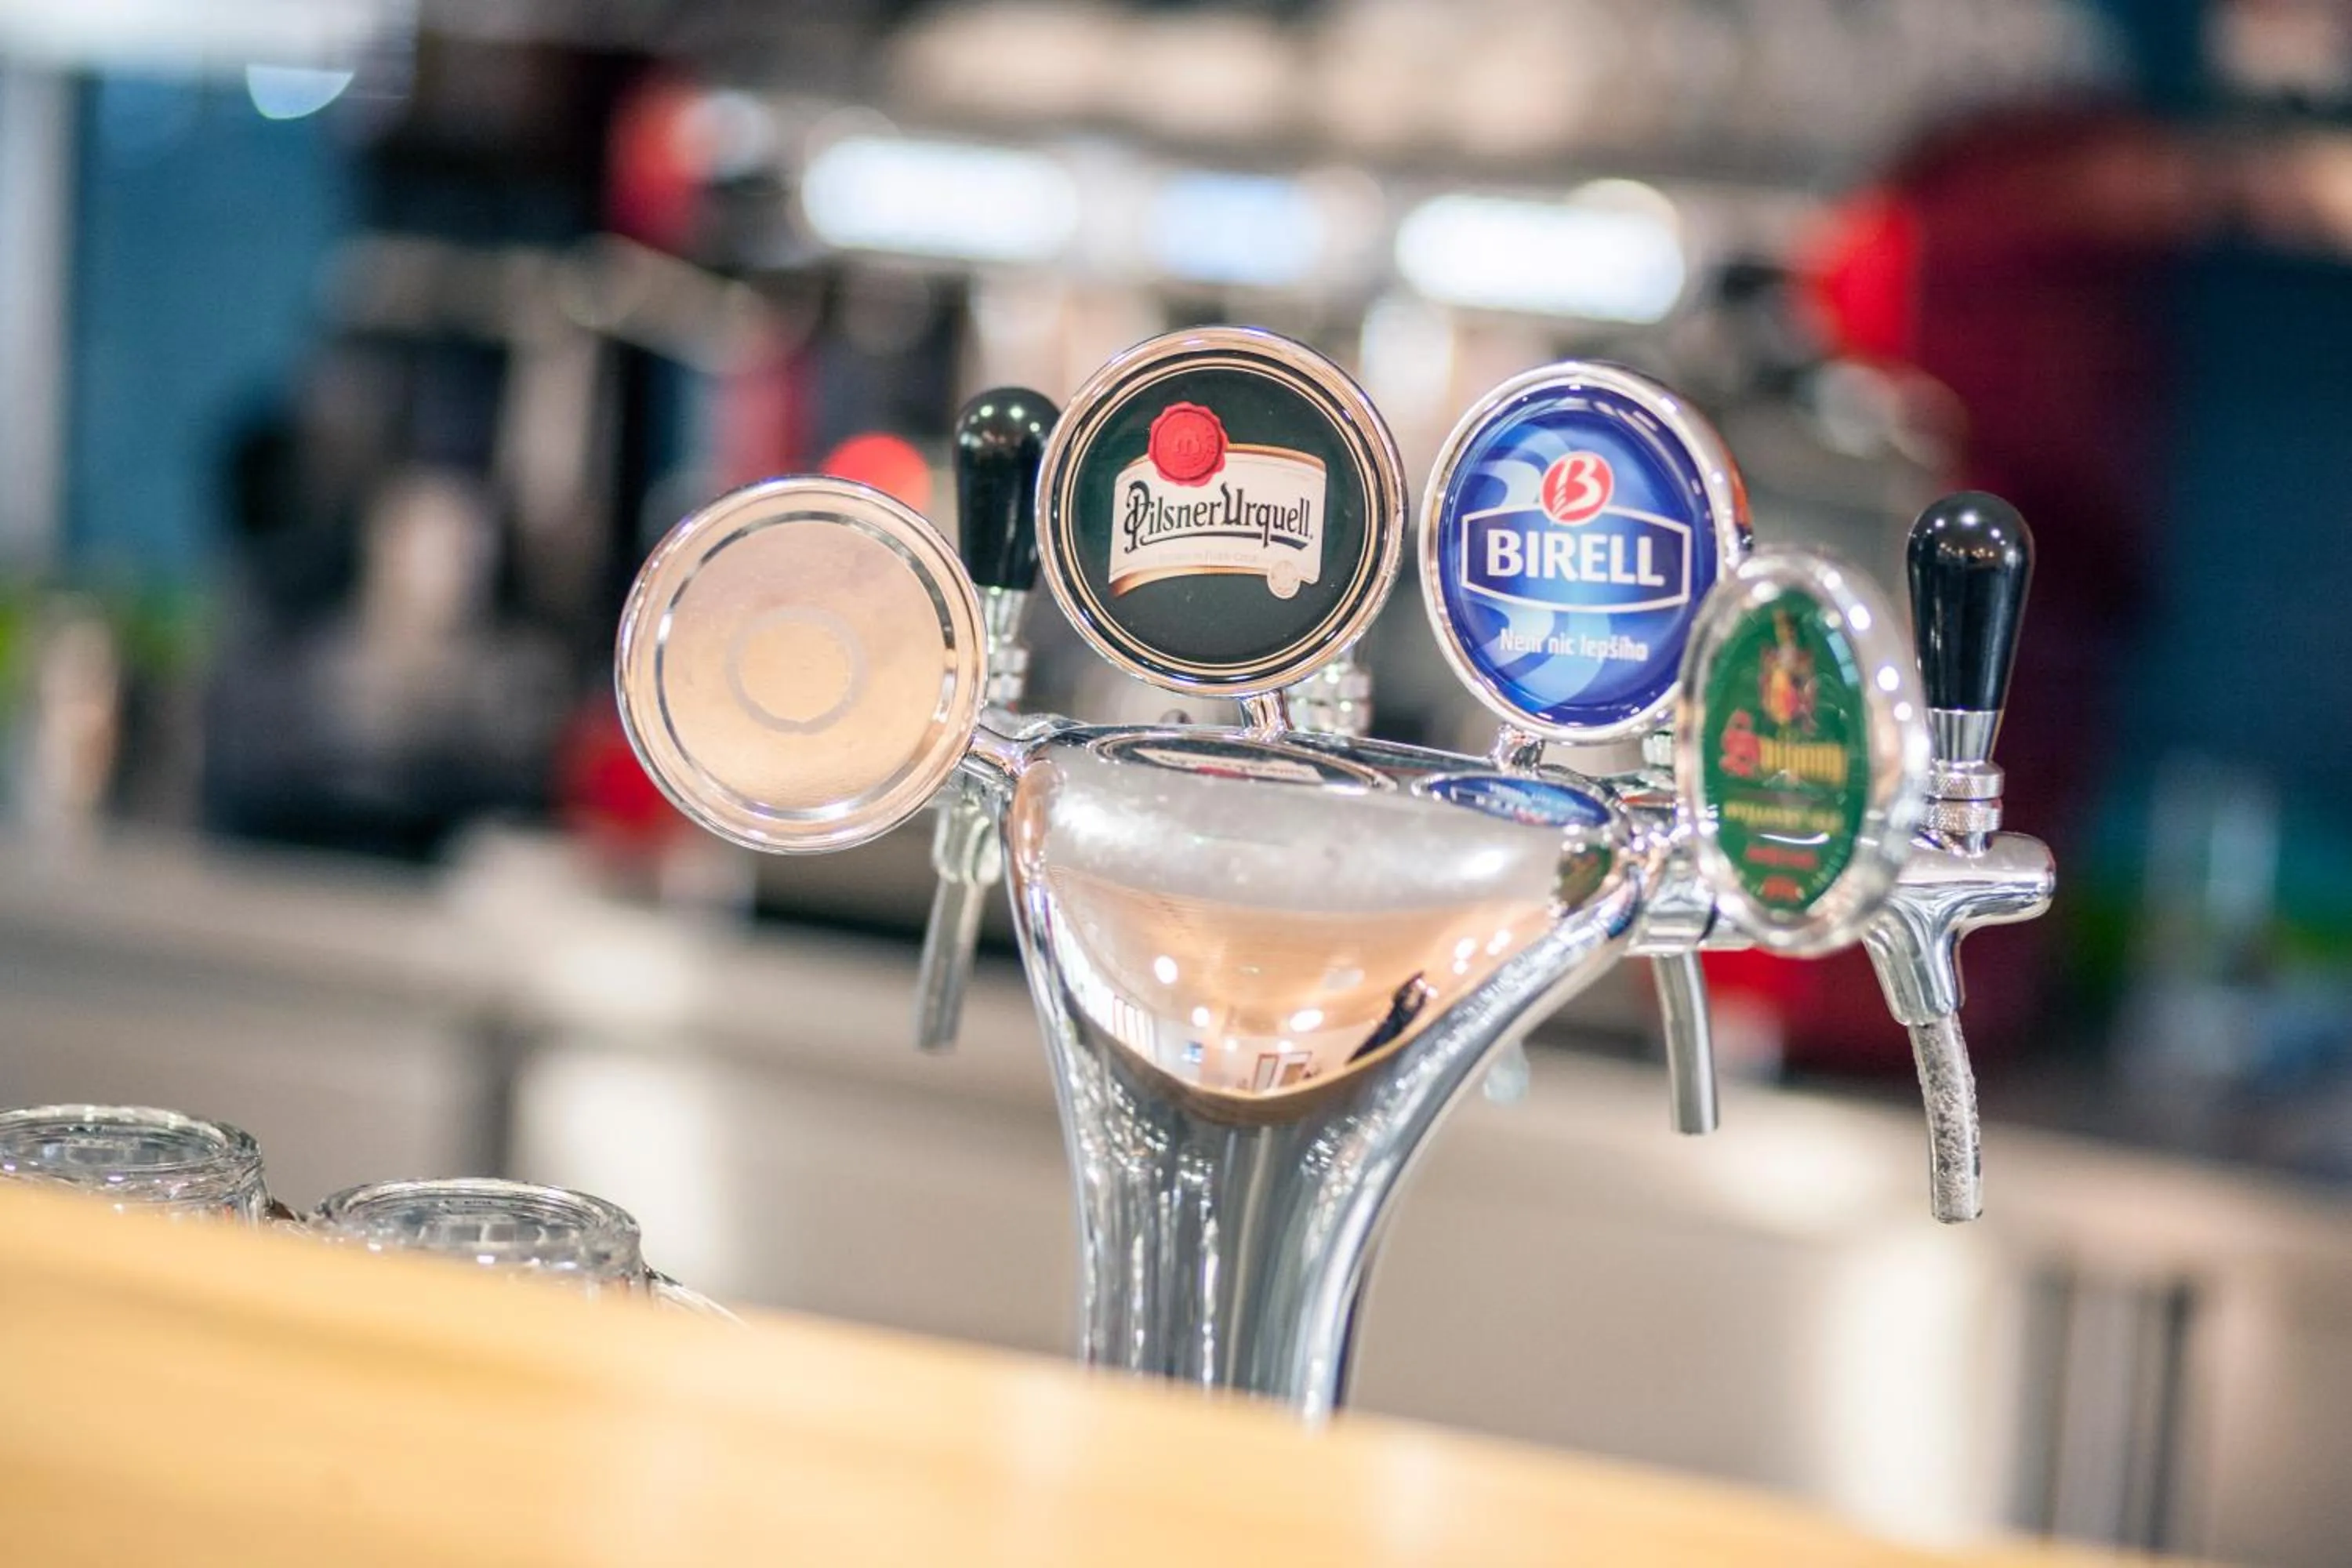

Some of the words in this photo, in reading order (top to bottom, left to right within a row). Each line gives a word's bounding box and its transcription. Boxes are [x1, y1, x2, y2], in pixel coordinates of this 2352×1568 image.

[1124, 481, 1221, 553] Pilsner
[1221, 481, 1311, 548] Urquell
[1486, 528, 1665, 586] BIRELL
[1548, 632, 1575, 655] nic
